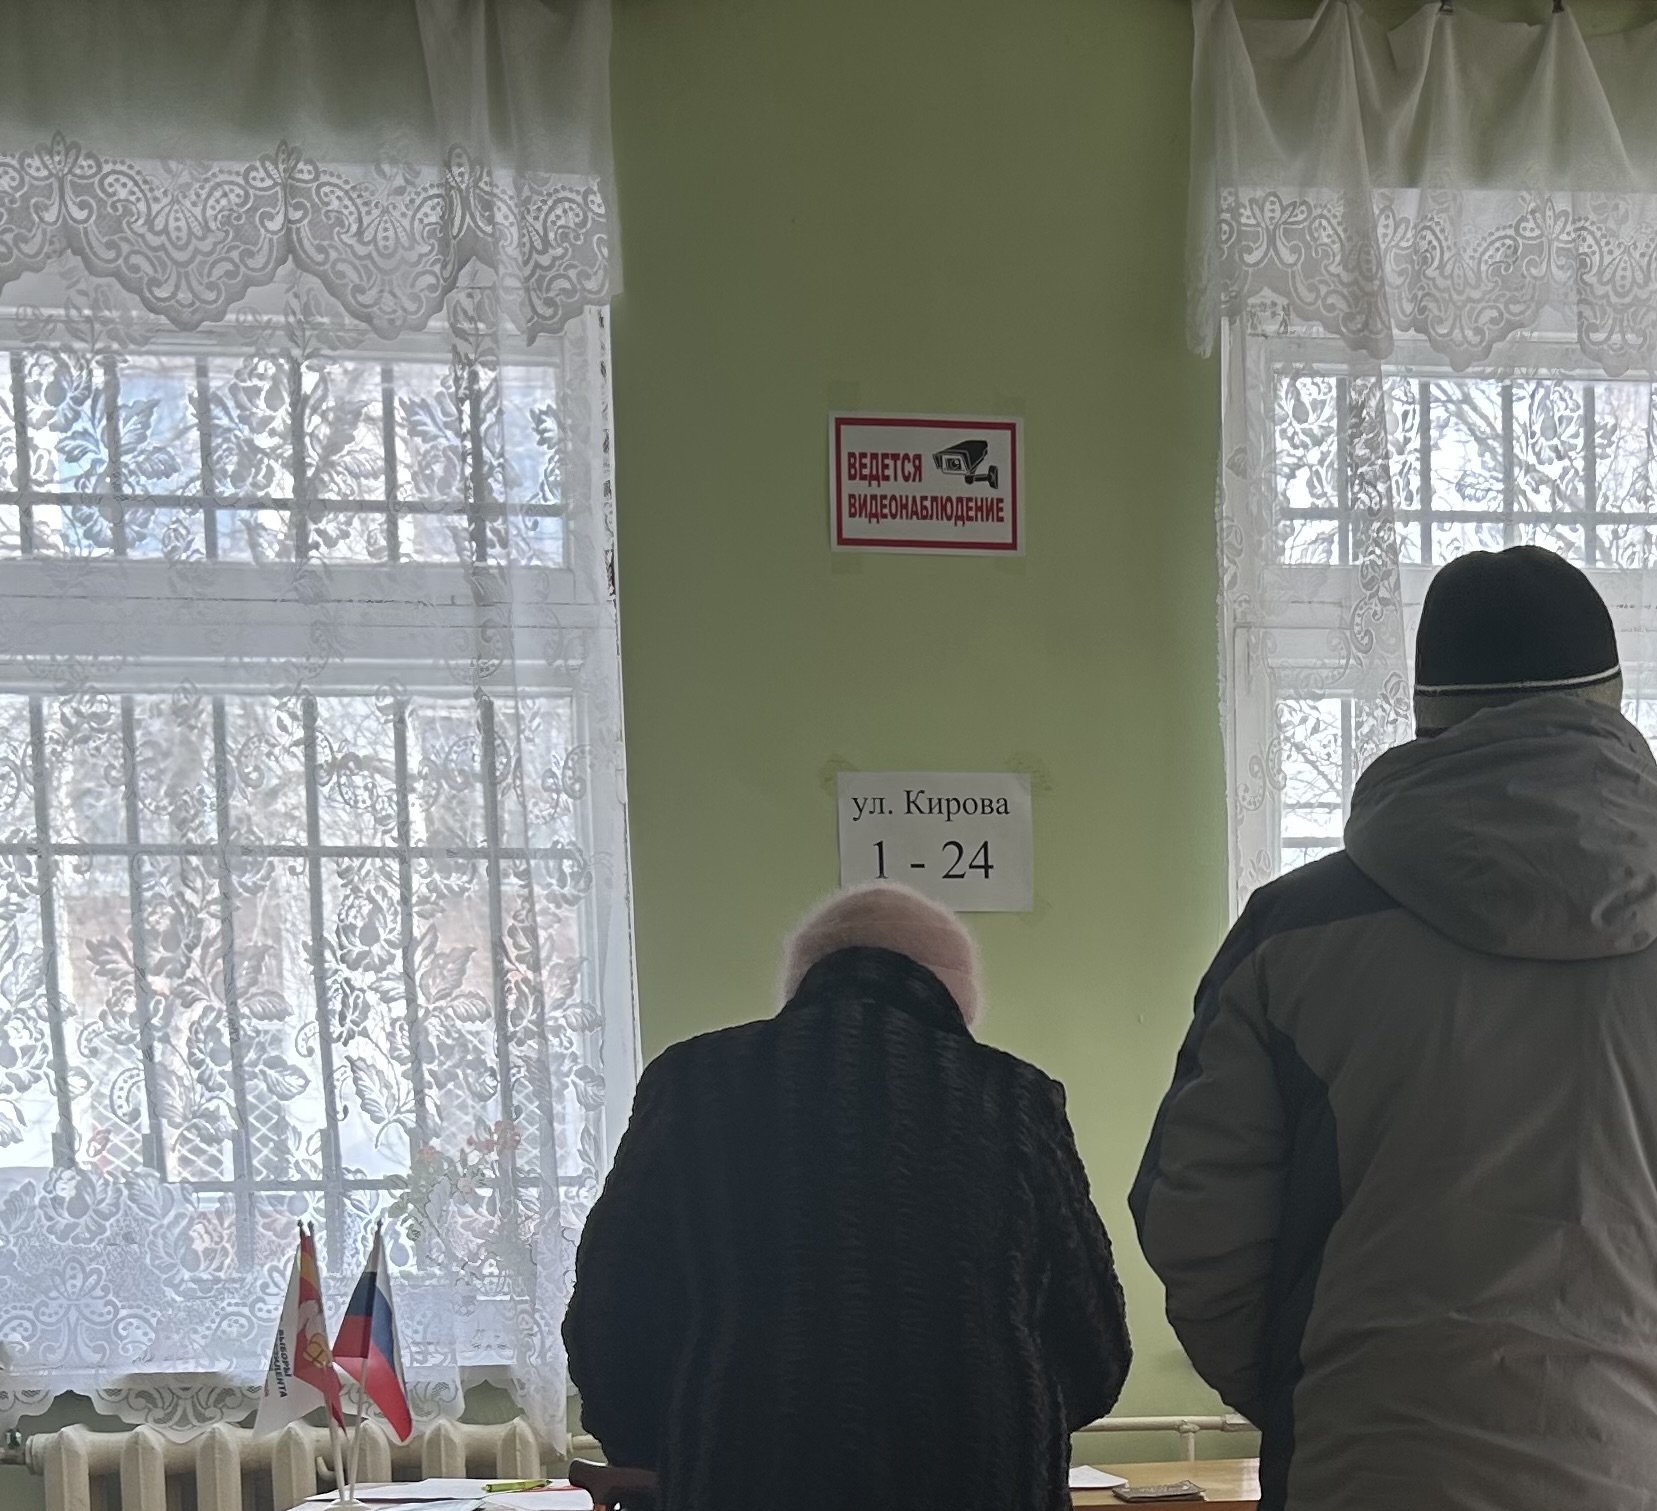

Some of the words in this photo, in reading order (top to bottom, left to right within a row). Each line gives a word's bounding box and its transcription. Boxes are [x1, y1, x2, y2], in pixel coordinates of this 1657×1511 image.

[847, 451, 923, 488] ВЕДЕТСЯ
[847, 493, 1005, 528] ВИДЕОНАБЛЮДЕНИЕ
[851, 797, 893, 822] ул.
[903, 789, 1011, 822] Кирова
[872, 840, 889, 879] 1
[941, 840, 995, 879] 24
